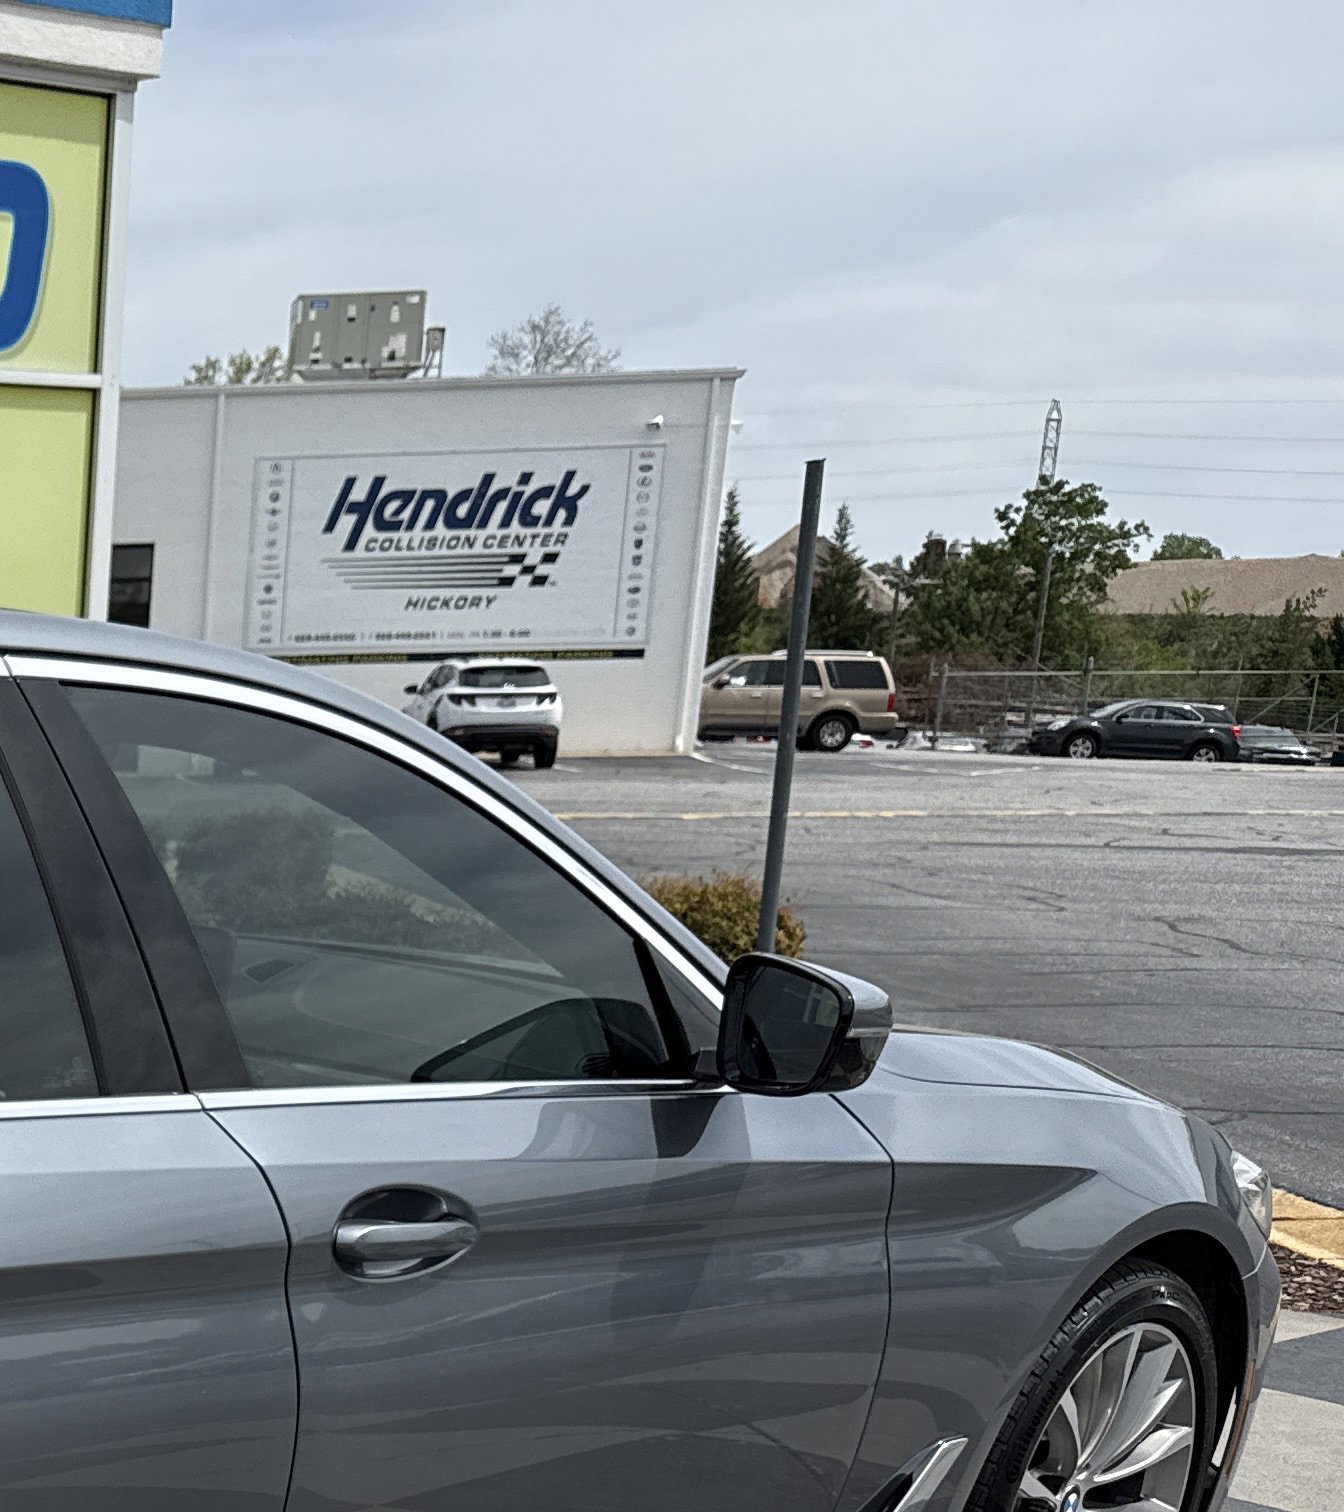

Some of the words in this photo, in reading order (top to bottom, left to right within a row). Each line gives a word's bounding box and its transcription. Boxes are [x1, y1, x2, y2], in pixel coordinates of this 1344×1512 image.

[321, 468, 592, 553] Hendrick
[363, 535, 478, 554] COLLISION
[481, 531, 570, 549] CENTER
[403, 594, 499, 611] HICKORY
